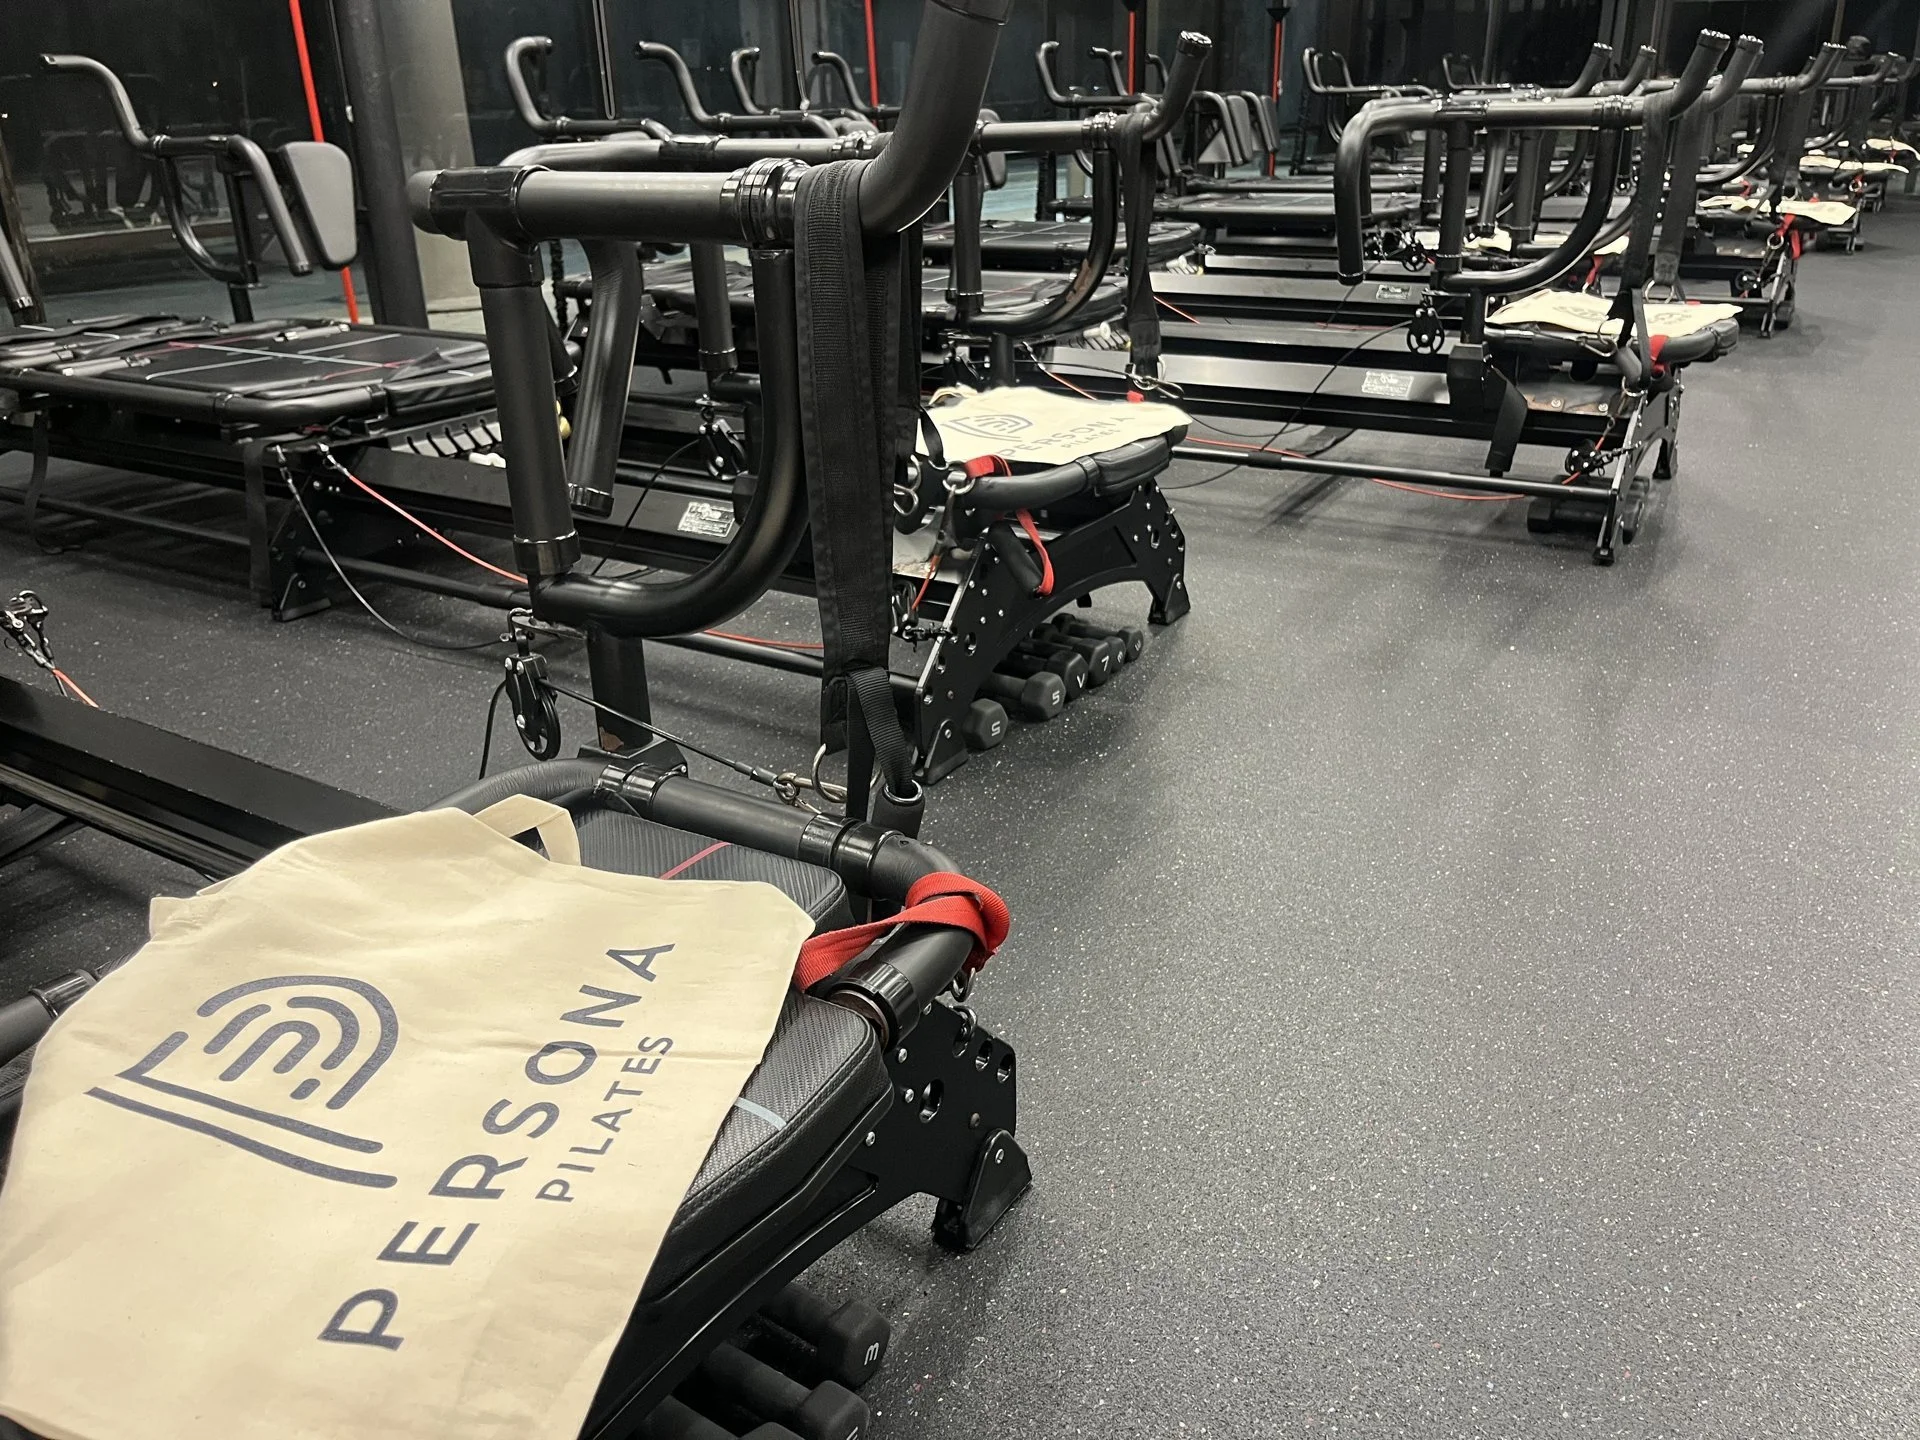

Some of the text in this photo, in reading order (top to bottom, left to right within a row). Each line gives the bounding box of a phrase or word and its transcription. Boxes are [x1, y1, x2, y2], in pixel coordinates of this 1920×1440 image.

[996, 416, 1136, 458] PERSONA
[1052, 690, 1060, 705] 5
[991, 721, 1001, 736] 5
[535, 1036, 674, 1203] PILATES
[317, 943, 675, 1352] PERSONA
